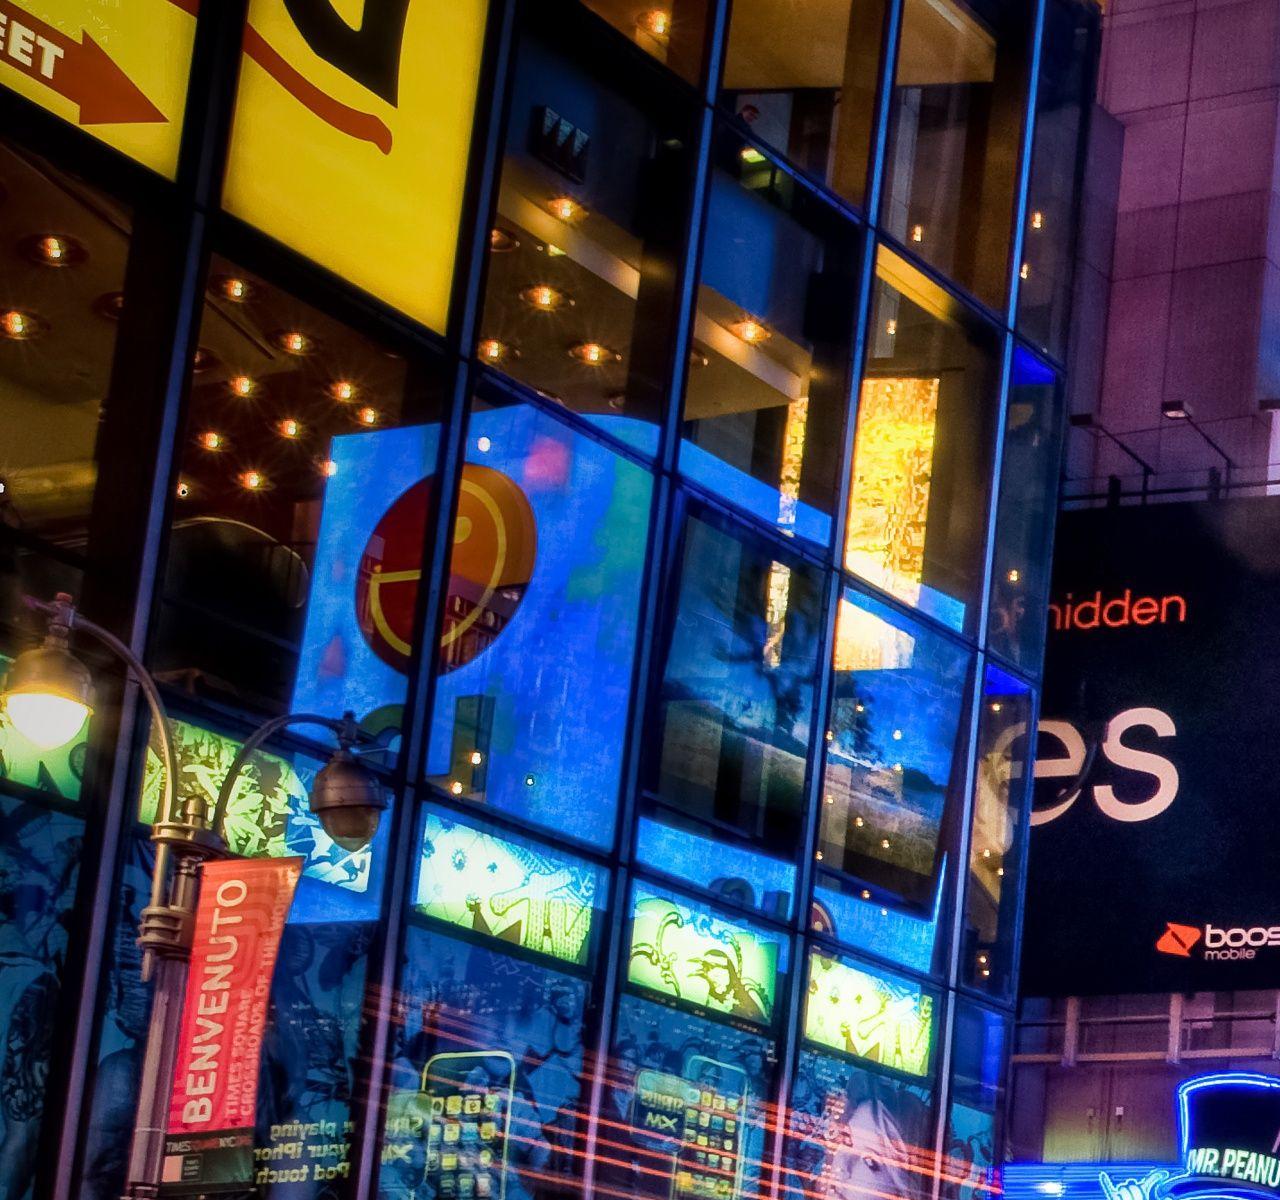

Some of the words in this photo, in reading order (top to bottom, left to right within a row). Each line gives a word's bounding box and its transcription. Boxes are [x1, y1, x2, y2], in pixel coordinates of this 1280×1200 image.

[0, 12, 65, 80] EET
[1204, 946, 1256, 961] mobile
[182, 878, 248, 1125] BENVENUTO
